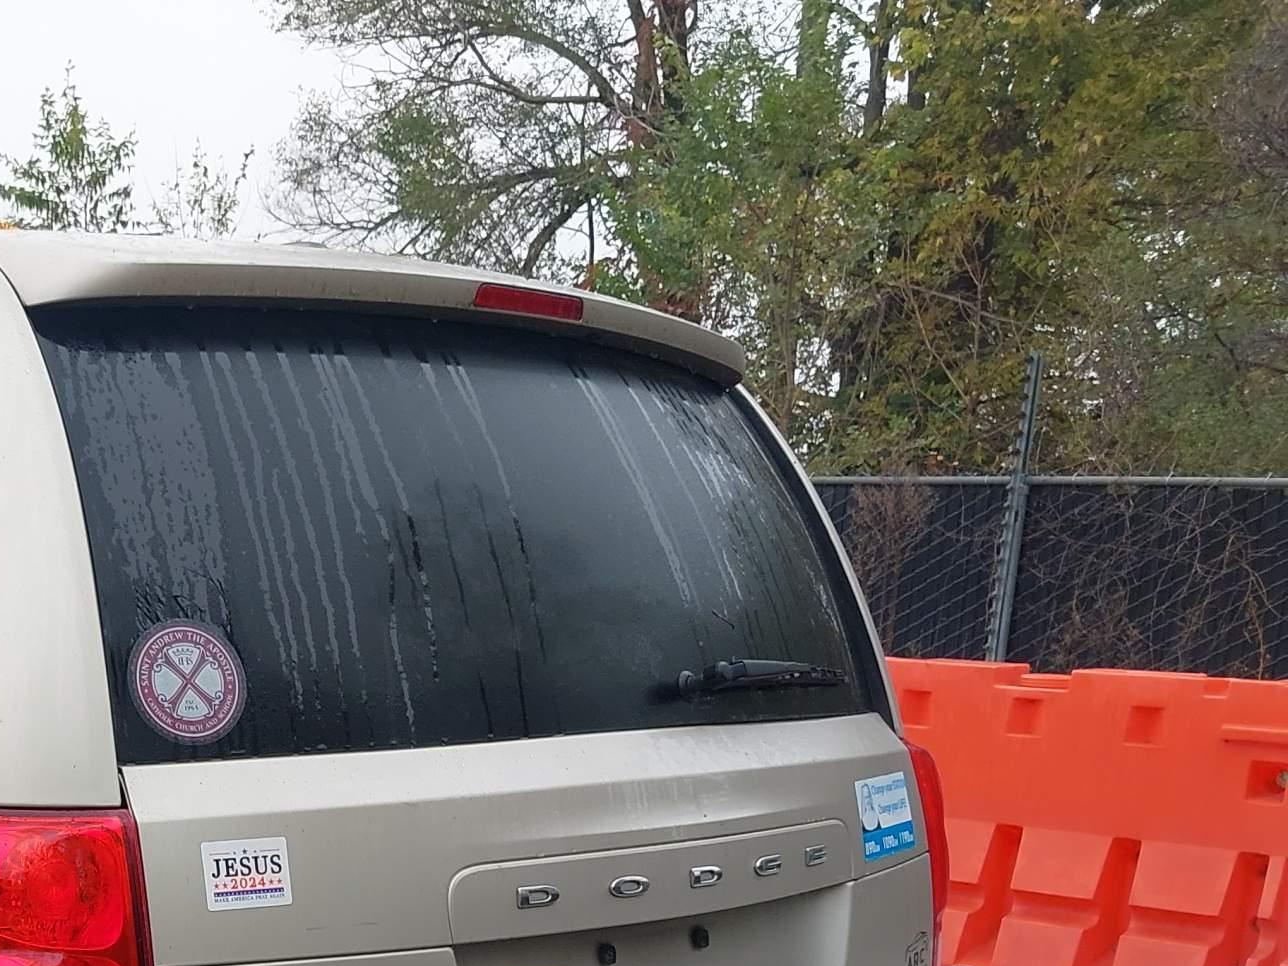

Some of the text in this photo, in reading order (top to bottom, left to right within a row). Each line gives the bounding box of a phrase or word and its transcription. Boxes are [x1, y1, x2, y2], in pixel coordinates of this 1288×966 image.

[140, 632, 234, 686] SAINT ANDREW THE APOSTLE
[147, 694, 234, 732] CATHOLIC CHURCH AND SCHOOL
[211, 854, 283, 879] JESUS
[230, 876, 267, 890] 2024
[516, 845, 828, 910] DODGE
